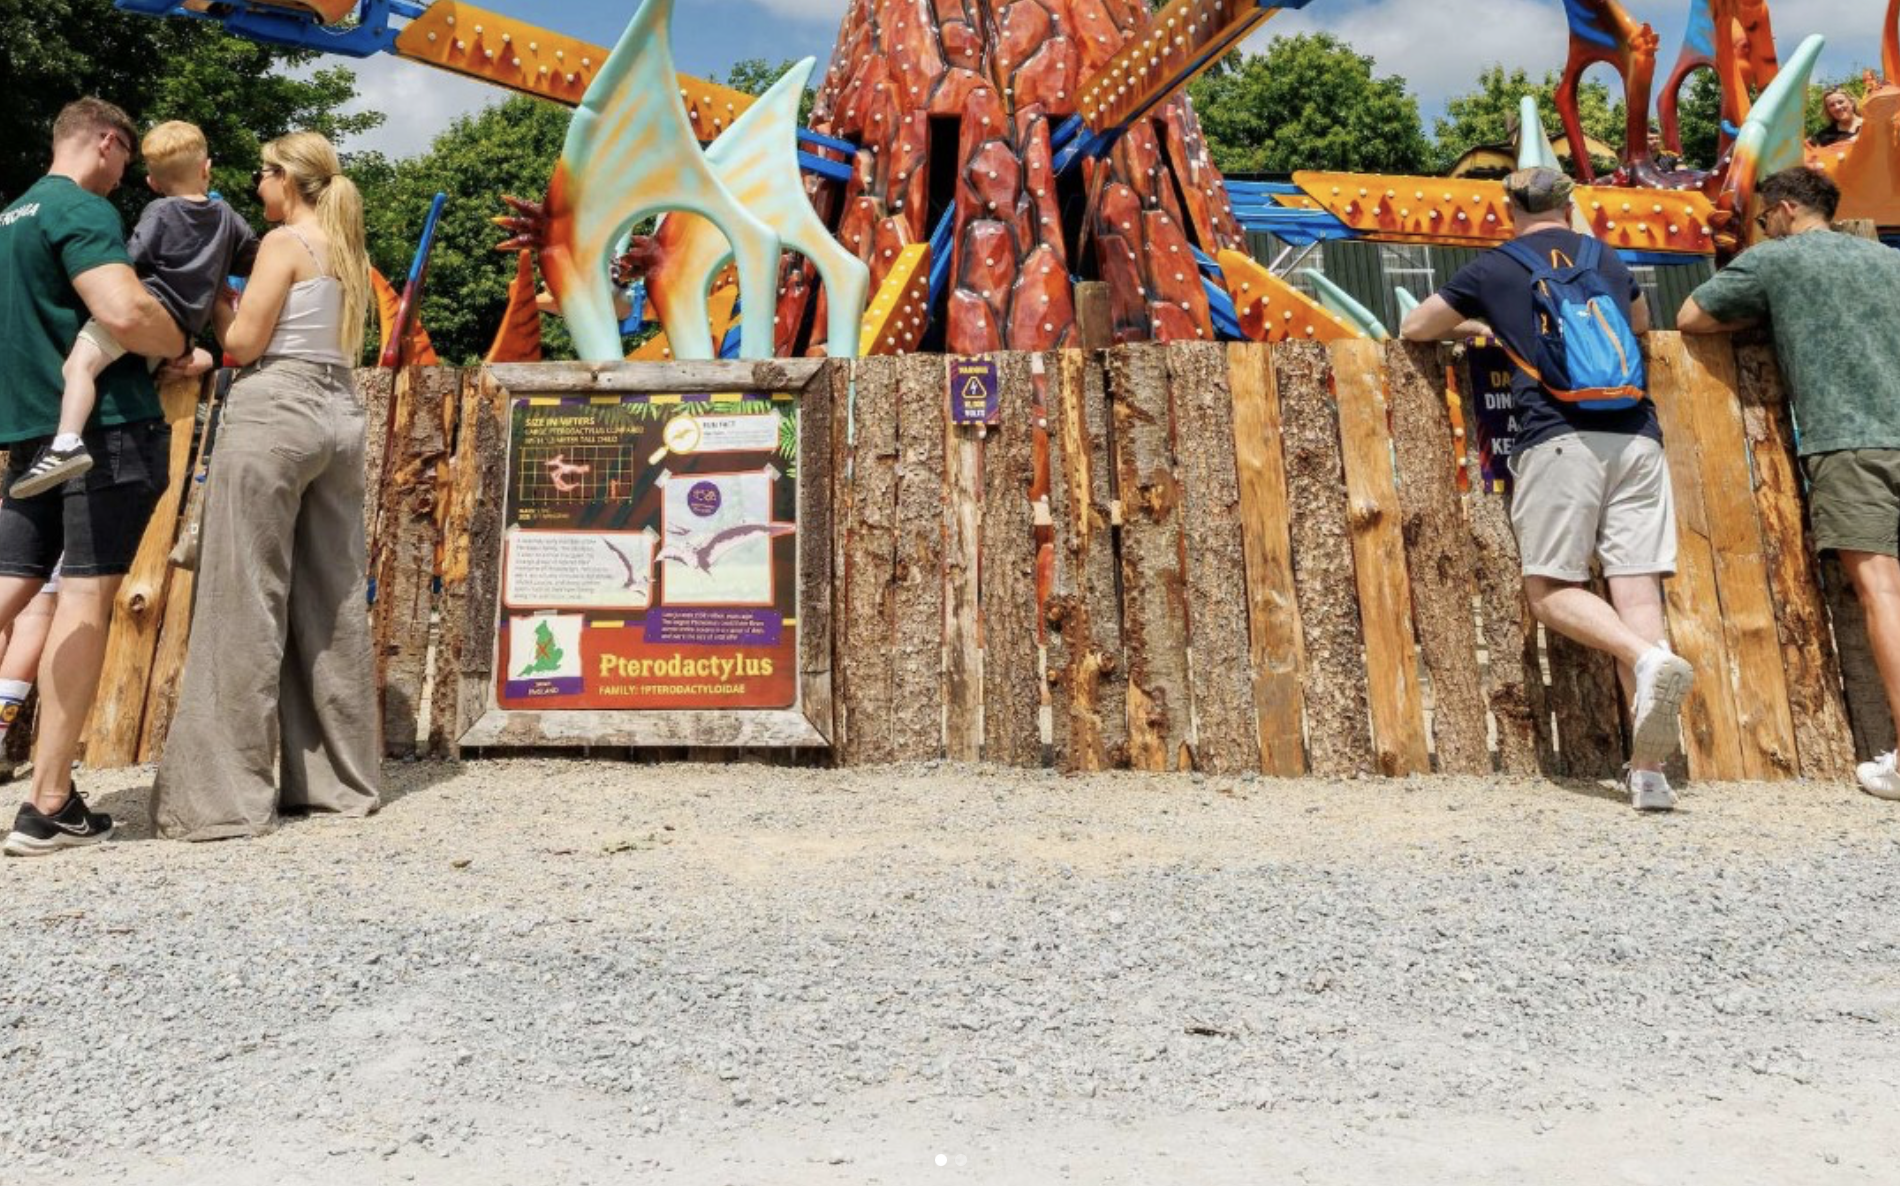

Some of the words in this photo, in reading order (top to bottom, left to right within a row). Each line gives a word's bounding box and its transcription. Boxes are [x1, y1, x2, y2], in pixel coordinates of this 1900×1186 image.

[1490, 370, 1511, 387] DA
[1484, 392, 1514, 409] DIN
[599, 653, 774, 682] Pterodactylus
[599, 685, 638, 695] FAMILY:
